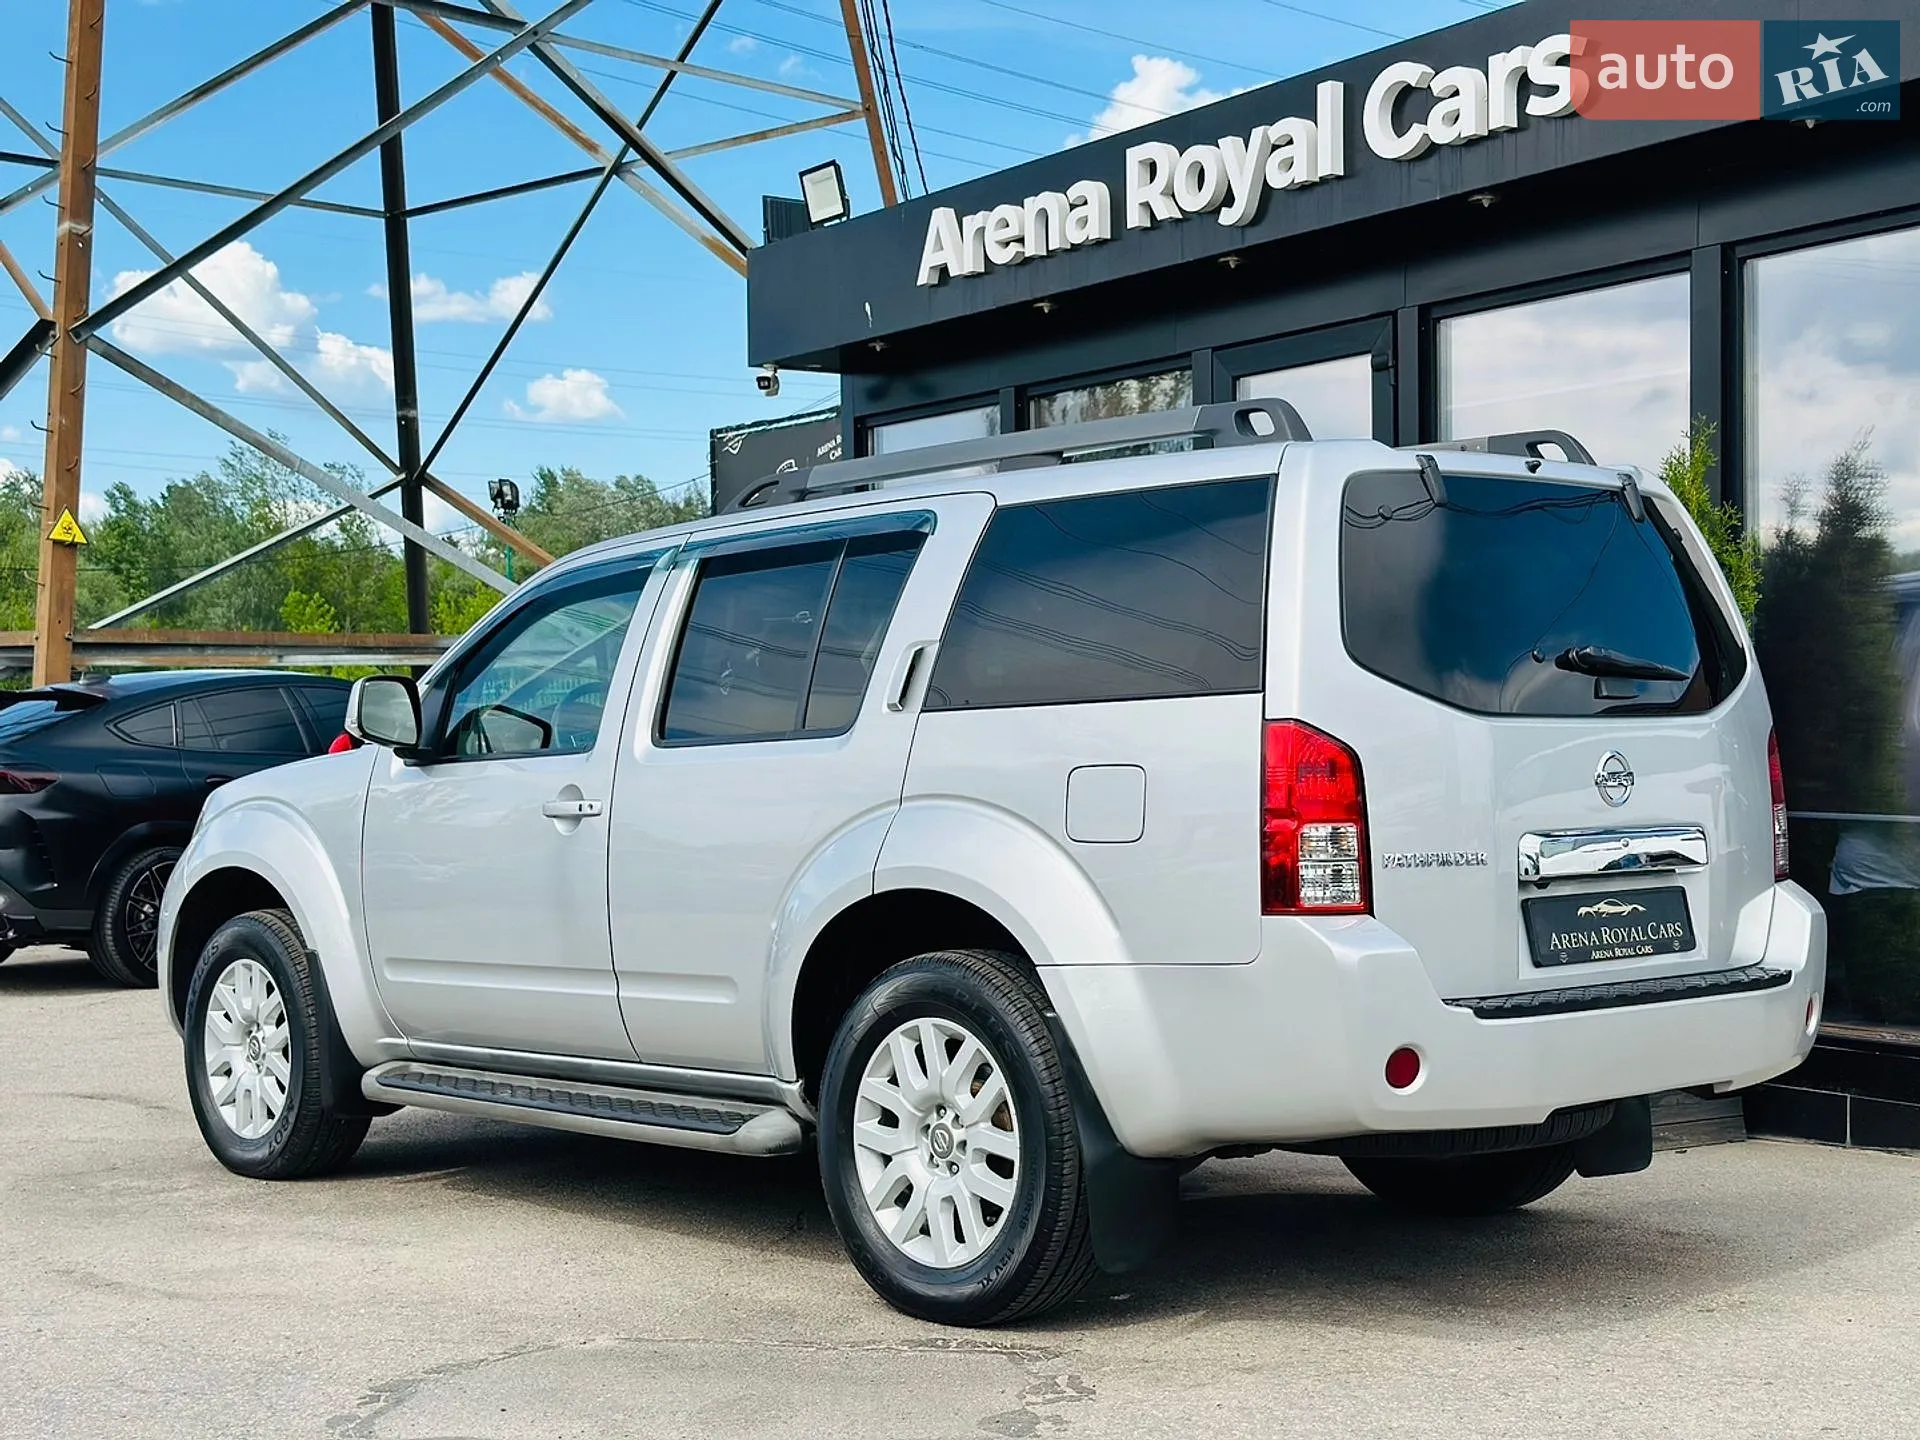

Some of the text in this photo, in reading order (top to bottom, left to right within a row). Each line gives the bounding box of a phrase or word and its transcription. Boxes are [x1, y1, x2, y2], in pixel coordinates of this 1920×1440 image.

[915, 34, 1592, 287] Arena Royal Cars
[829, 447, 843, 460] CAR
[1382, 851, 1489, 869] PATHFINDER
[1550, 922, 1684, 950] ARENA ROYAL CARS
[1590, 944, 1654, 960] ARENA ROYAL CARS
